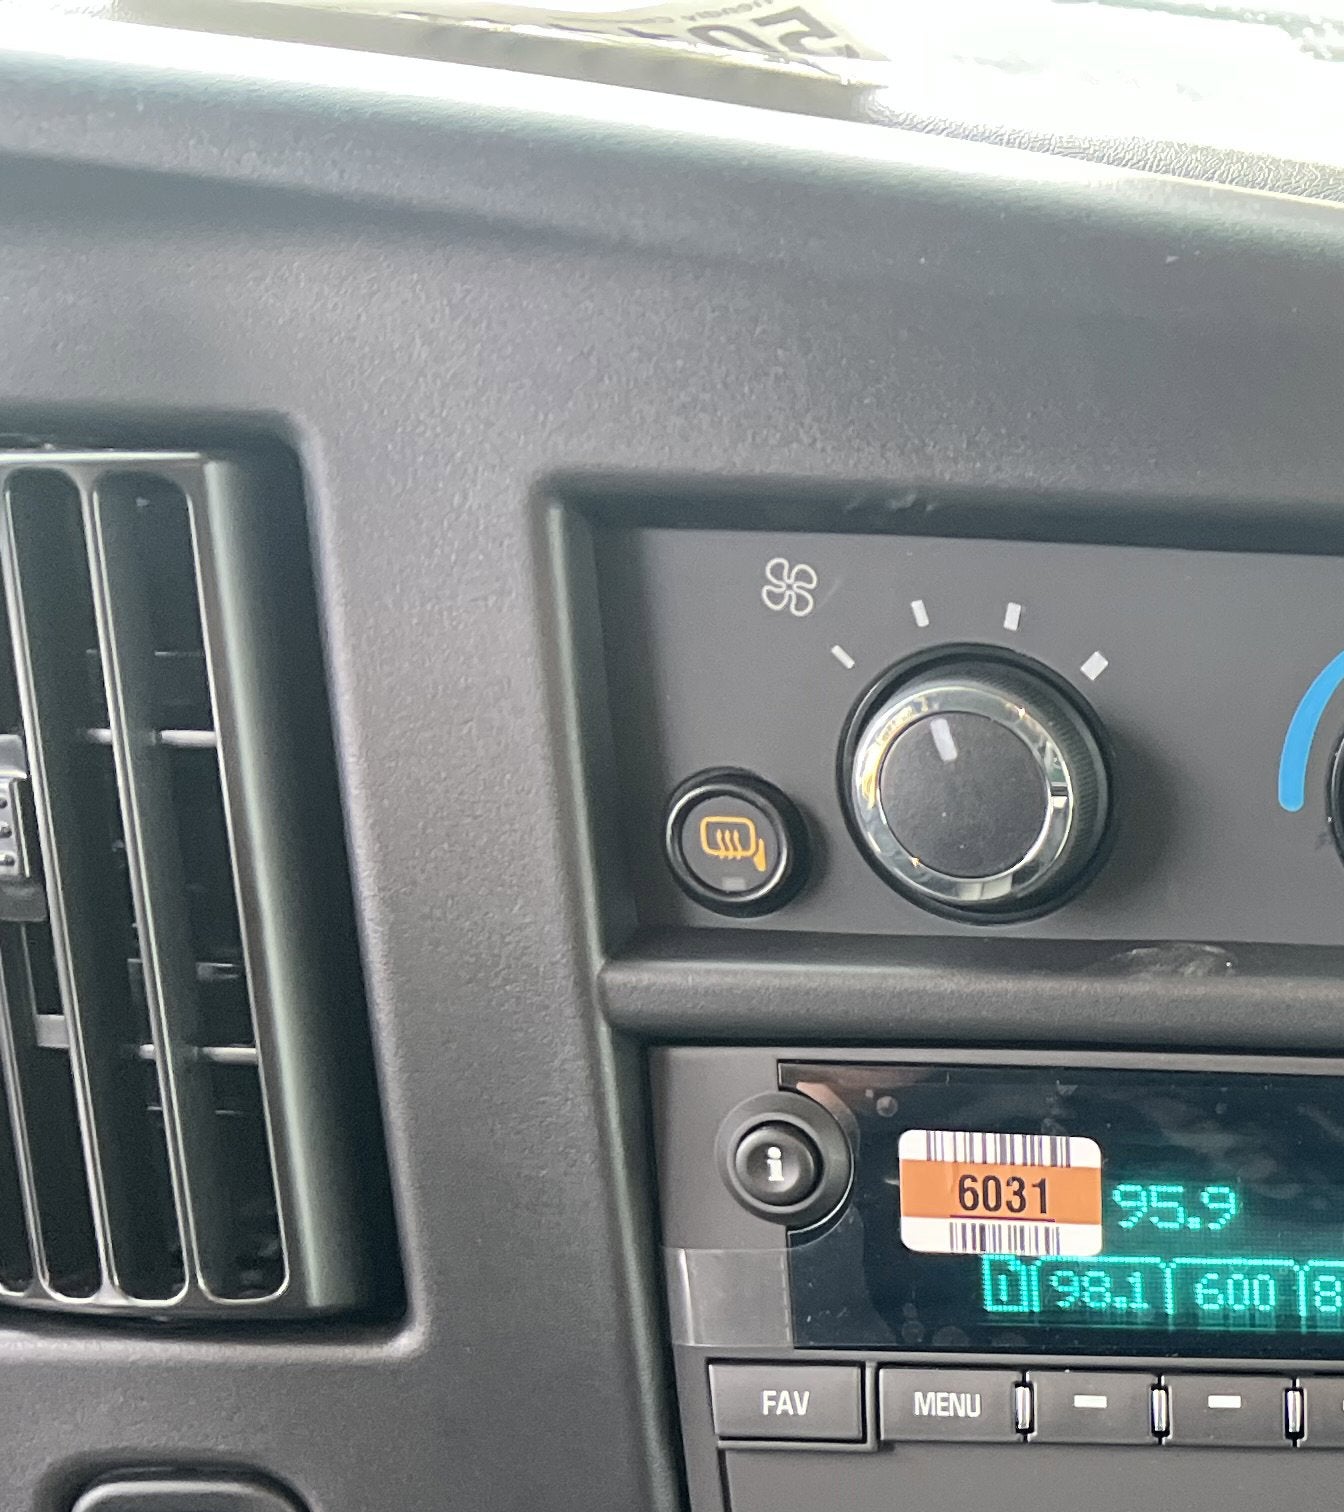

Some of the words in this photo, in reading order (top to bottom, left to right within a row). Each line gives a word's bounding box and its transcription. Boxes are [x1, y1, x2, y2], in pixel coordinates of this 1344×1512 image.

[957, 1174, 1049, 1214] 6031
[1113, 1184, 1238, 1230] 95.9
[1049, 1270, 1150, 1309] 98.1
[1195, 1274, 1277, 1312] 600
[762, 1391, 810, 1416] FAV
[913, 1391, 982, 1418] MENU
